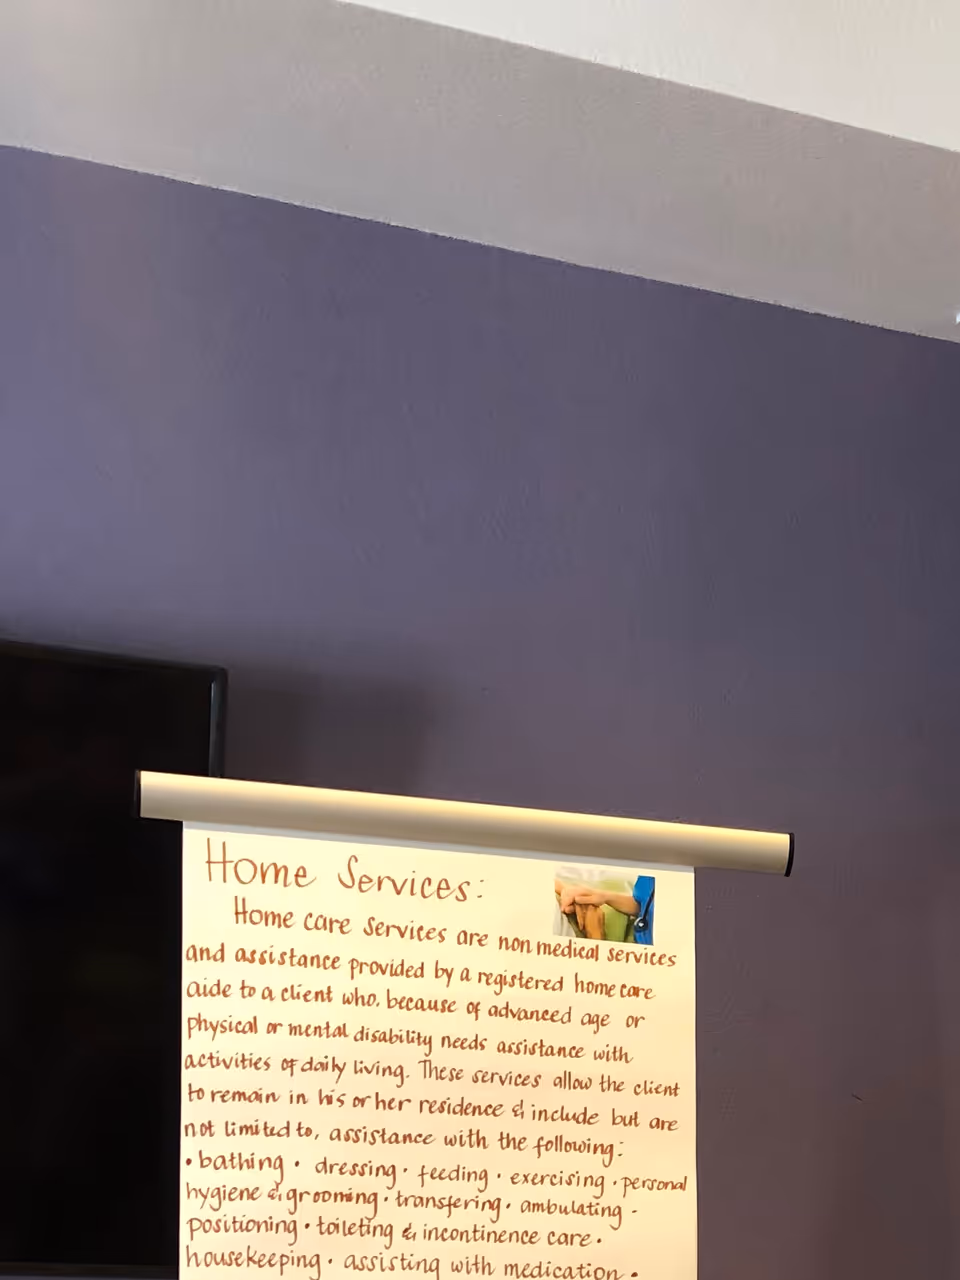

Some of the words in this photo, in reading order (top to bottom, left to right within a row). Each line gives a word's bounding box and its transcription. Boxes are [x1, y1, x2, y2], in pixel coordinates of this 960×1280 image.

[205, 838, 316, 888] Home
[338, 855, 484, 902] Services:
[234, 896, 294, 929] Home
[304, 912, 352, 935] care
[457, 930, 488, 947] are
[607, 948, 677, 967] services
[187, 942, 225, 963] and
[235, 945, 341, 970] assistance
[348, 958, 424, 980] provided
[435, 960, 454, 988] by
[460, 968, 472, 982] a
[478, 970, 563, 996] registered
[187, 978, 232, 998] aide
[239, 980, 256, 999] to
[261, 986, 276, 1001] a
[281, 984, 333, 1002] client
[387, 988, 457, 1013] because
[466, 1001, 480, 1021] of
[488, 1001, 572, 1024] advanced
[581, 1013, 610, 1034] age
[626, 1015, 645, 1028] or
[266, 1022, 283, 1034] or
[288, 1021, 349, 1039] mental
[354, 1026, 432, 1057] disability
[441, 1034, 487, 1051] needs
[497, 1039, 585, 1058] assistance
[594, 1044, 633, 1064] with
[185, 1051, 271, 1071] activities
[281, 1058, 299, 1077] of
[301, 1055, 346, 1084] daily
[354, 1060, 409, 1088] living.
[418, 1059, 464, 1082] These
[472, 1070, 542, 1088] services
[553, 1070, 592, 1090] allow
[599, 1074, 625, 1092] the
[634, 1080, 680, 1097] client
[188, 1083, 205, 1102] to
[211, 1088, 280, 1104] remain
[290, 1090, 308, 1104] in
[318, 1089, 346, 1107] his
[353, 1095, 371, 1108] or
[375, 1092, 411, 1111] her
[420, 1097, 504, 1117] residence
[512, 1099, 524, 1119] &
[531, 1104, 599, 1125] include
[612, 1108, 640, 1127] but
[649, 1117, 678, 1131] are
[185, 1120, 215, 1137] not
[225, 1119, 290, 1138] limited
[296, 1122, 319, 1140] to,
[329, 1126, 436, 1146] assistance
[444, 1128, 489, 1149] with
[498, 1131, 527, 1151] the
[532, 1135, 624, 1168] following:
[199, 1150, 284, 1188] bathing
[315, 1157, 396, 1190] dressing
[418, 1164, 488, 1193] feeding
[510, 1171, 604, 1199] exercising
[620, 1176, 687, 1198] personal
[187, 1182, 262, 1212] hygiene
[268, 1183, 282, 1201] &
[286, 1188, 378, 1223] grooming
[395, 1190, 501, 1224] transfering
[521, 1199, 622, 1231] ambulating
[186, 1214, 297, 1246] positioning
[316, 1215, 393, 1250] toileting
[402, 1223, 416, 1241] &
[423, 1224, 540, 1245] incontinence
[547, 1231, 592, 1247] care
[451, 1254, 495, 1276] with
[504, 1261, 624, 1280] medication
